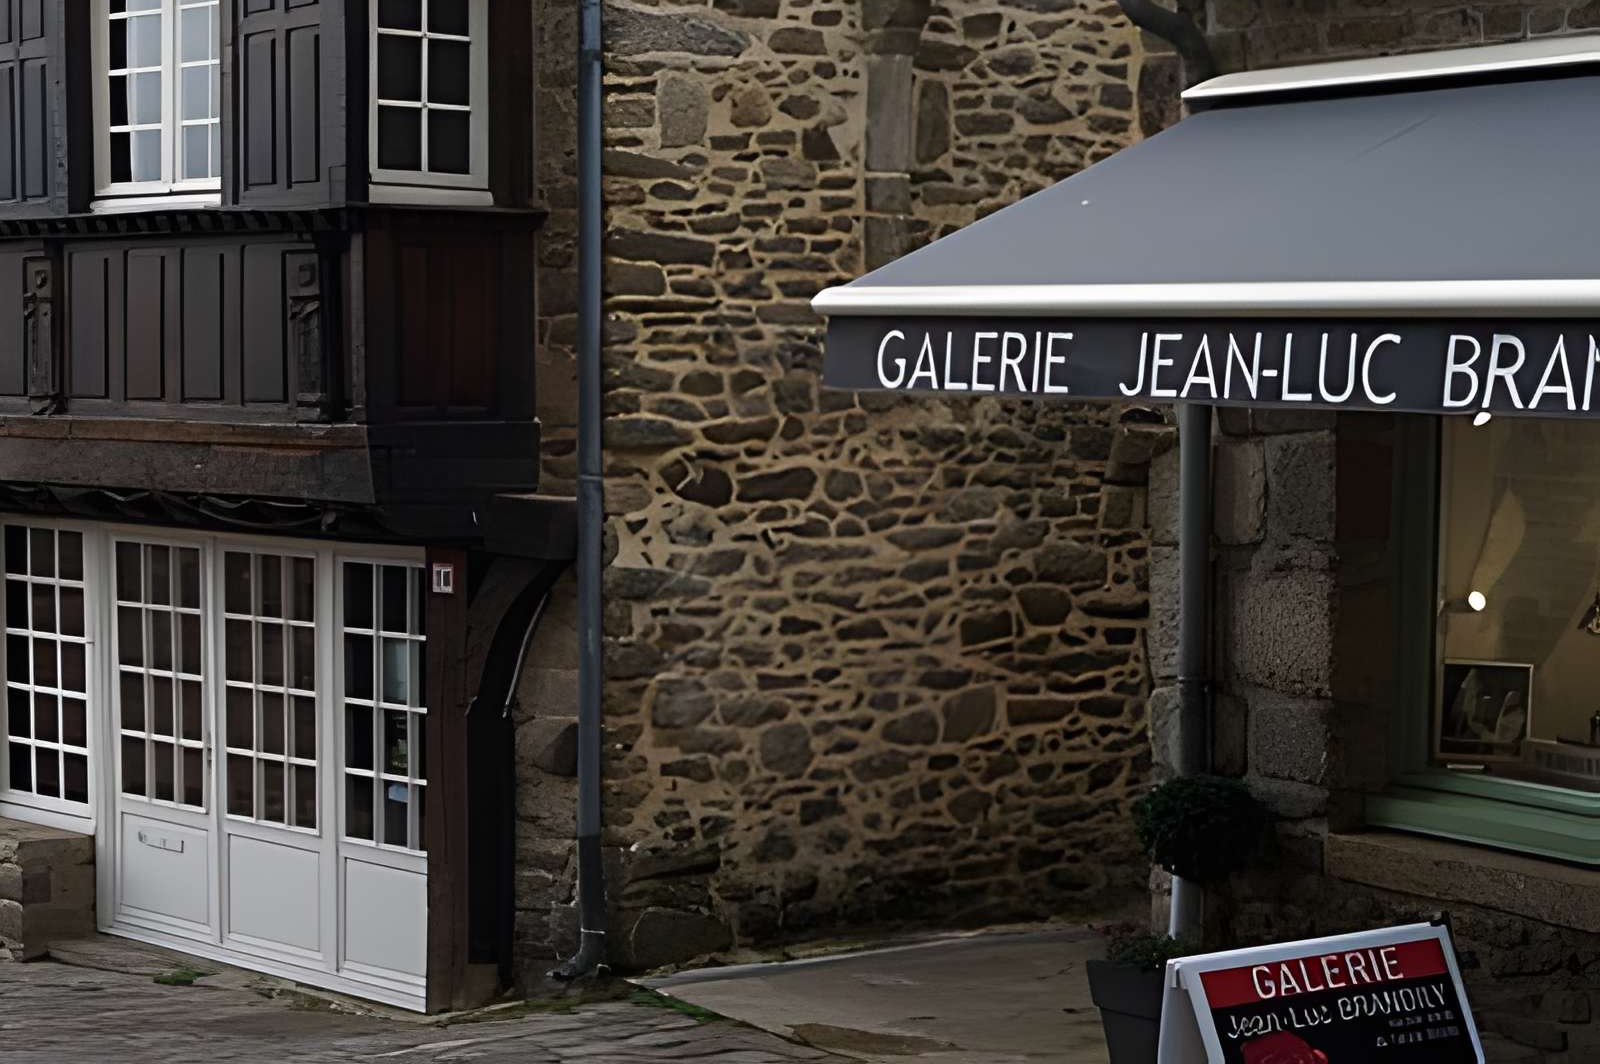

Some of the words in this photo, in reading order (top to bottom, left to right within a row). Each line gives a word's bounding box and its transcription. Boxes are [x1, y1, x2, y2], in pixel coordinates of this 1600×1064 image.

[877, 330, 1073, 394] GALERIE
[1119, 333, 1401, 404] JEAN-LUC
[1251, 947, 1404, 999] GALERIE
